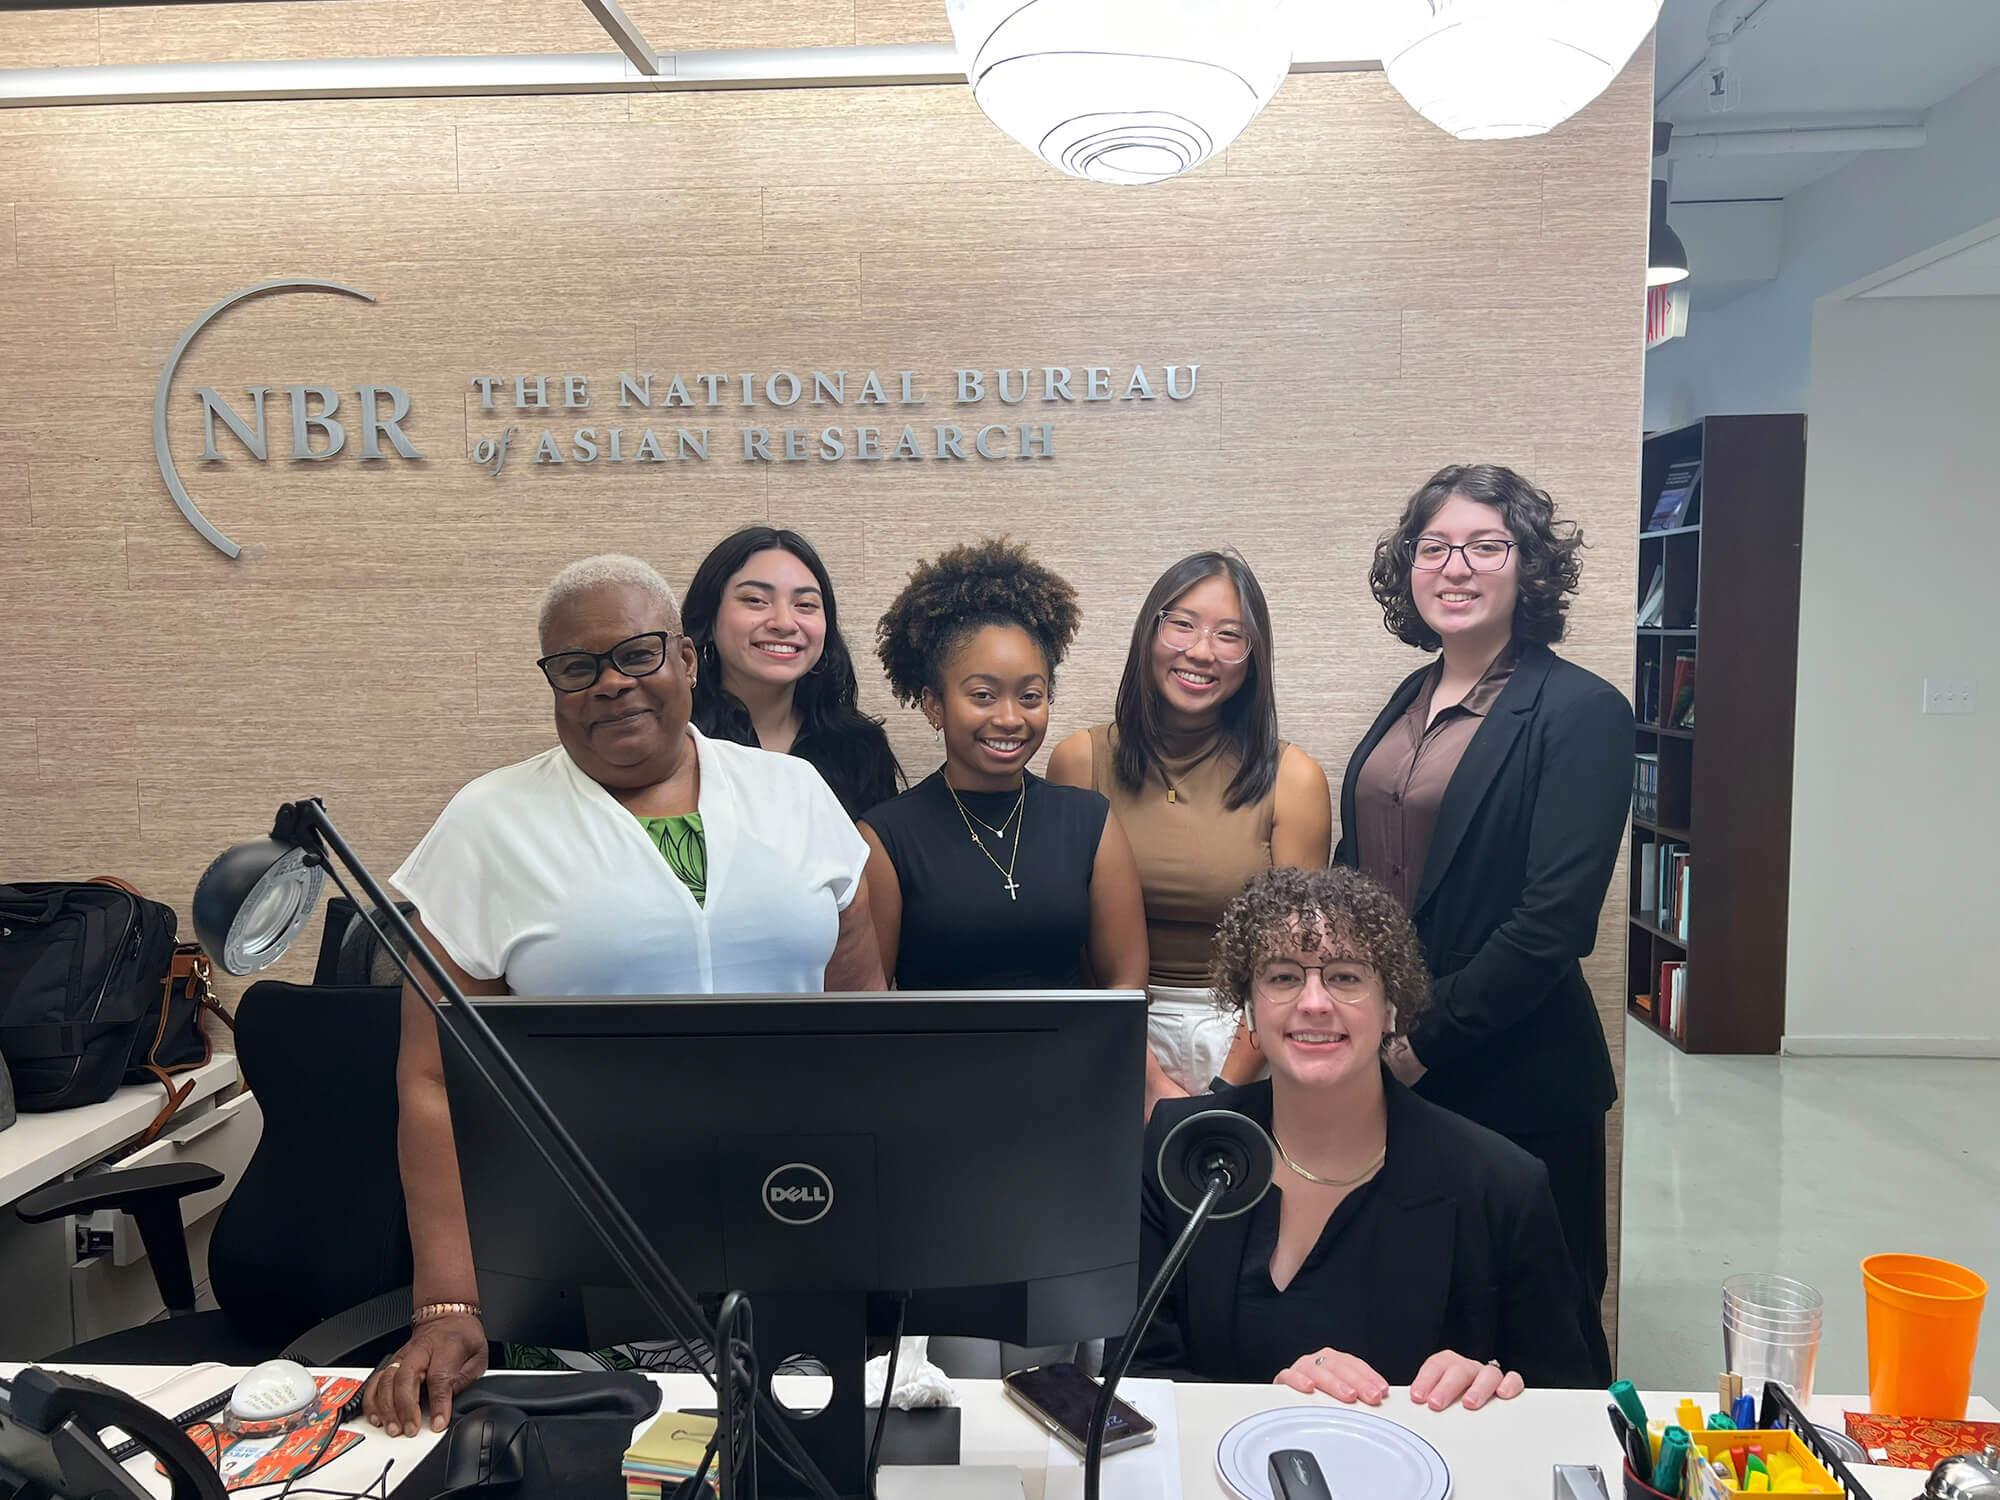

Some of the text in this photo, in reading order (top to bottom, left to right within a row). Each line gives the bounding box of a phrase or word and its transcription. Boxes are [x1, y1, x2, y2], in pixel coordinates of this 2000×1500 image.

[1647, 284, 1668, 342] XIT
[471, 364, 1200, 410] THE NATIONAL BUREAU
[195, 384, 421, 462] NBR
[471, 424, 1056, 476] of ASIAN RESEARCH
[770, 1186, 826, 1202] DELL
